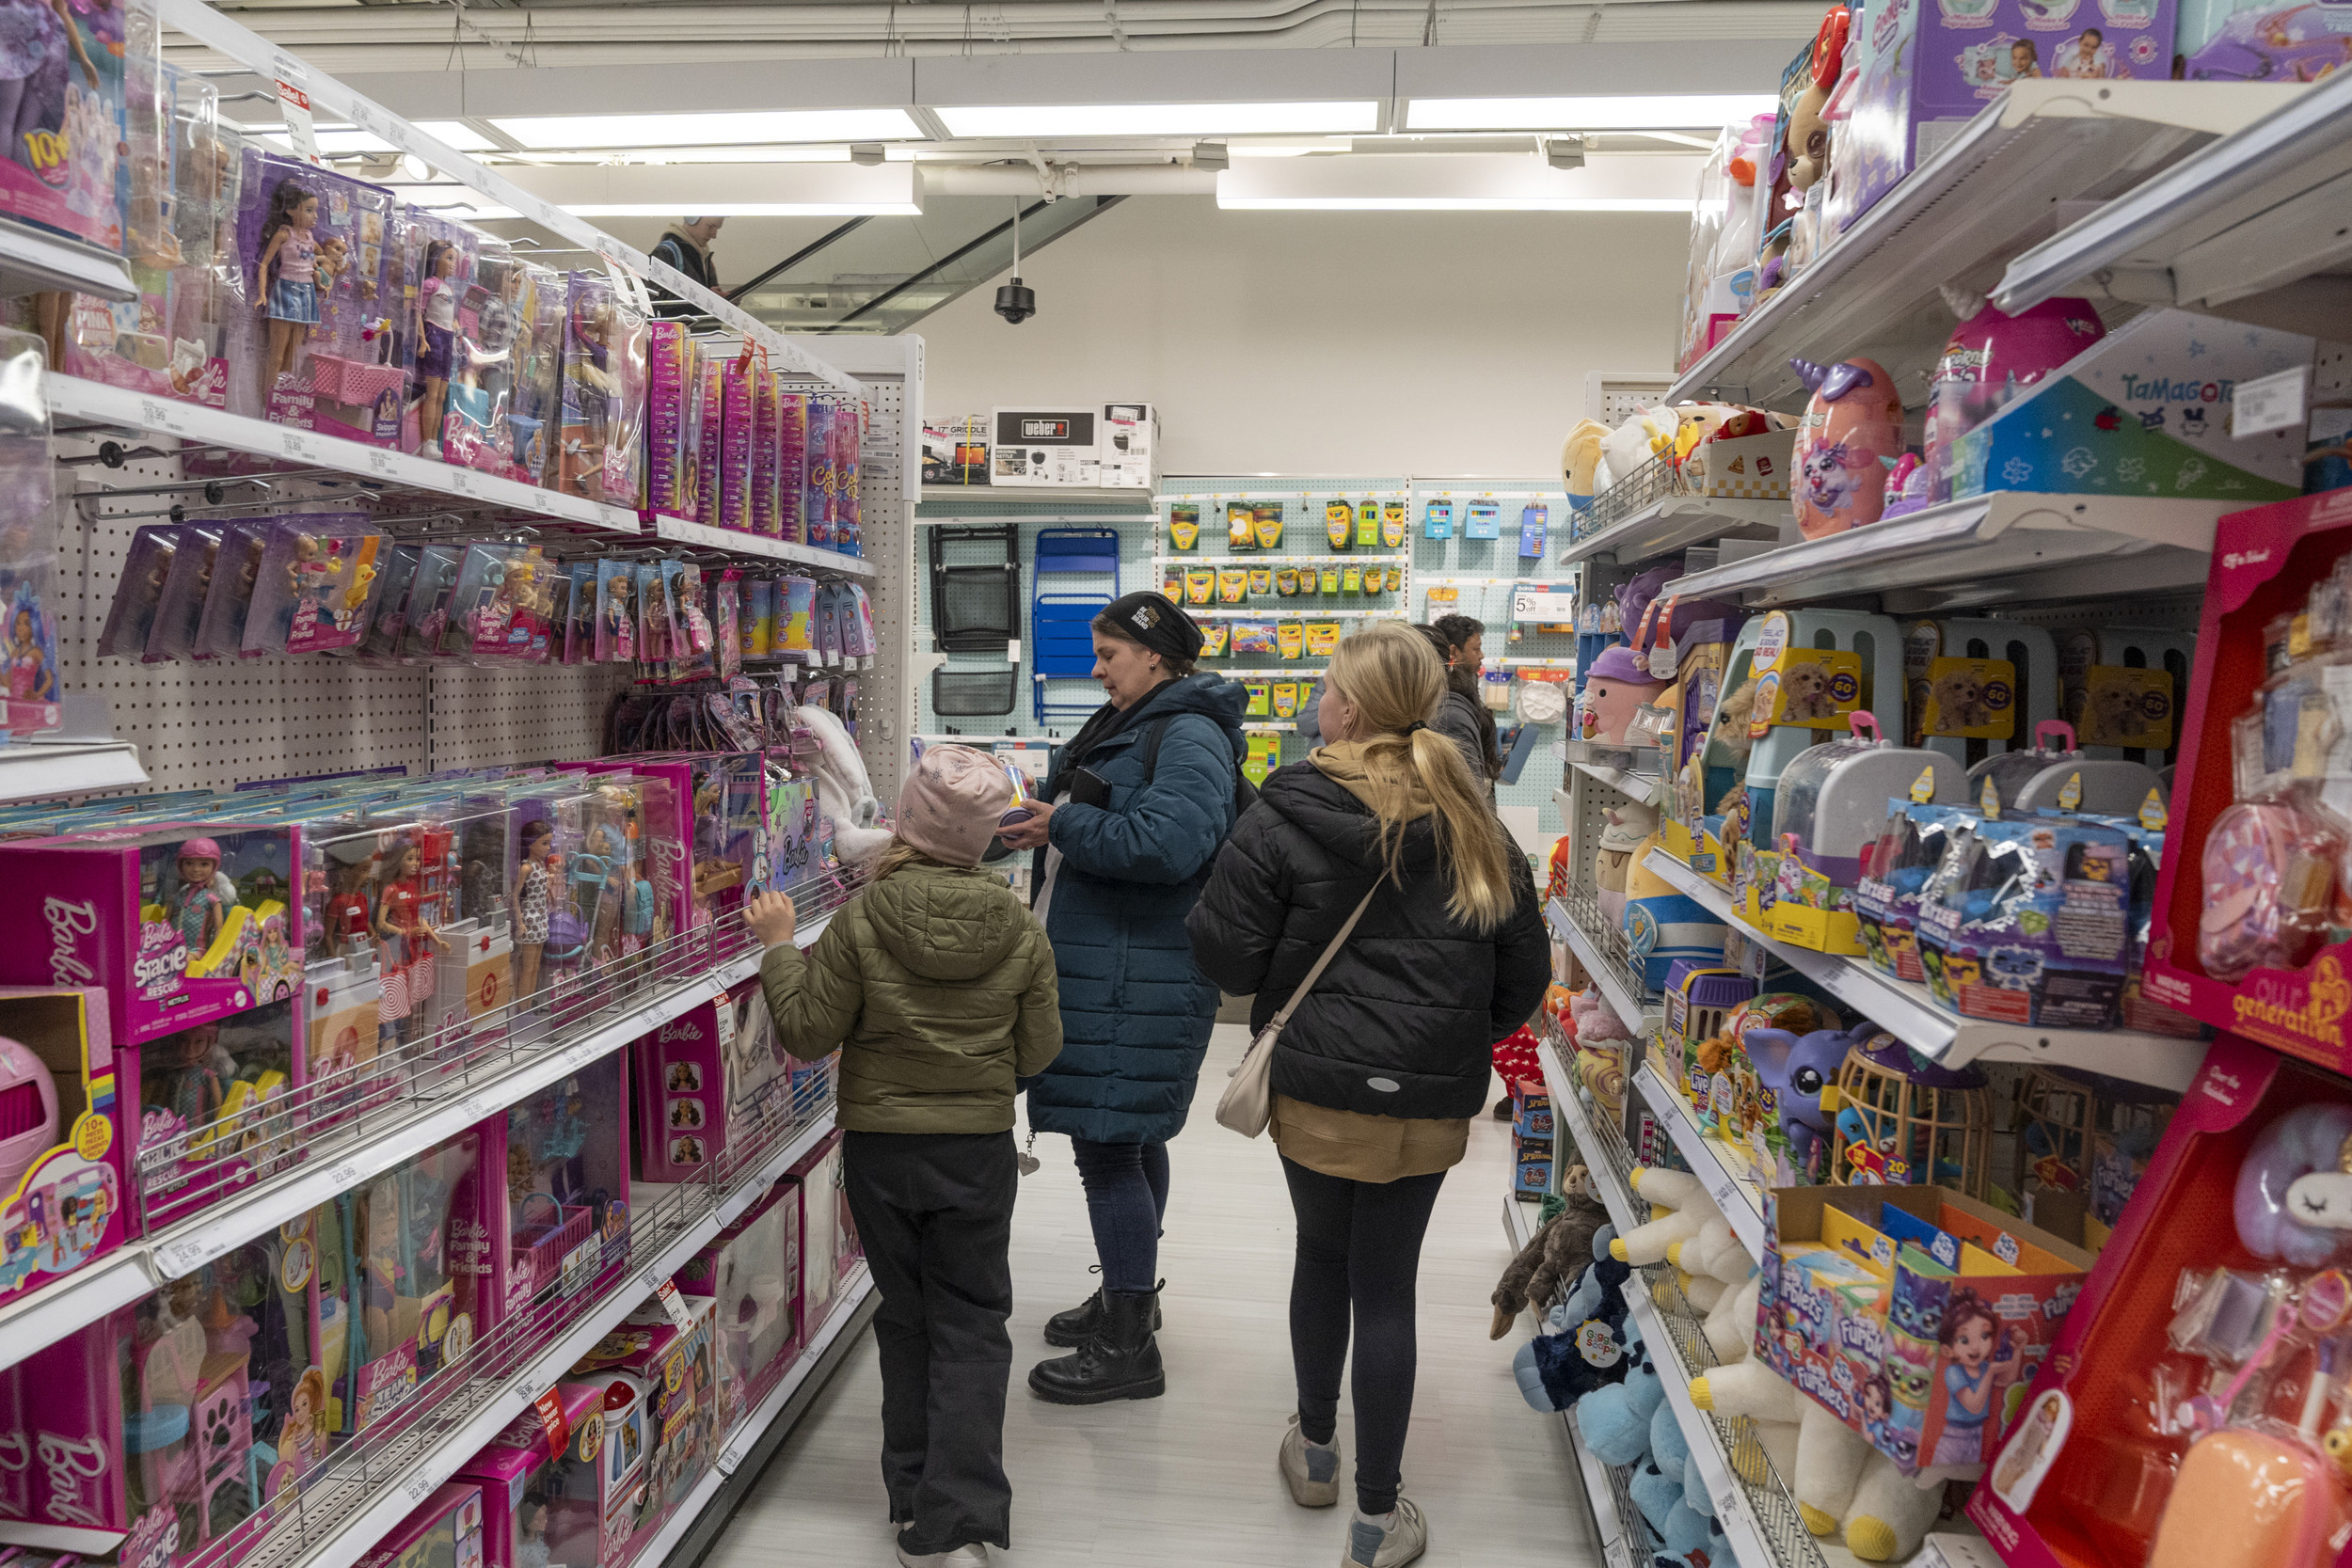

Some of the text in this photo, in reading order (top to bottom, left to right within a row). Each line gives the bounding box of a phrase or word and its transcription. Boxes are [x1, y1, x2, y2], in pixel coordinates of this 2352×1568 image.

[277, 81, 301, 105] Sale!
[655, 327, 680, 341] Barbie
[272, 392, 315, 409] Family
[783, 397, 803, 409] Barbie
[143, 407, 166, 421] 10.99
[287, 404, 299, 417] &
[1025, 420, 1056, 436] weber
[1131, 615, 1149, 630] BRAND
[1136, 610, 1150, 622] YOUR
[477, 633, 500, 642] Friends
[1762, 646, 1780, 657] REAL!
[782, 835, 809, 876] Barbie
[43, 895, 97, 987] Barbi
[147, 979, 180, 997] RESCUE
[167, 994, 189, 1007] NETFLIX
[714, 994, 725, 1007] Sale!
[660, 1022, 703, 1043] Barbie
[1691, 1071, 1709, 1094] Live
[463, 1102, 484, 1117] 22.99
[85, 1118, 104, 1132] 10+
[86, 1128, 103, 1139] PIECES
[143, 1110, 176, 1140] Barbie
[146, 1164, 181, 1190] RESCUE
[332, 1166, 357, 1184] 22.99
[451, 1219, 489, 1240] Barbie
[176, 1244, 202, 1263] 24.99
[450, 1239, 491, 1254] Family
[465, 1251, 477, 1263] &
[450, 1260, 493, 1275] Friends
[505, 1259, 531, 1298] Barbie
[505, 1281, 532, 1316] Family
[659, 1284, 672, 1301] Sale!
[1586, 1338, 1617, 1355] scape
[1839, 1317, 1883, 1361] Furbl
[371, 1350, 410, 1390] Barbie
[376, 1372, 408, 1402] TEAM
[517, 1385, 534, 1400] 29.99
[539, 1398, 554, 1415] New
[543, 1406, 559, 1424] lower
[497, 1414, 545, 1449] Barbi
[547, 1417, 561, 1435] price
[408, 1480, 430, 1500] 22.99
